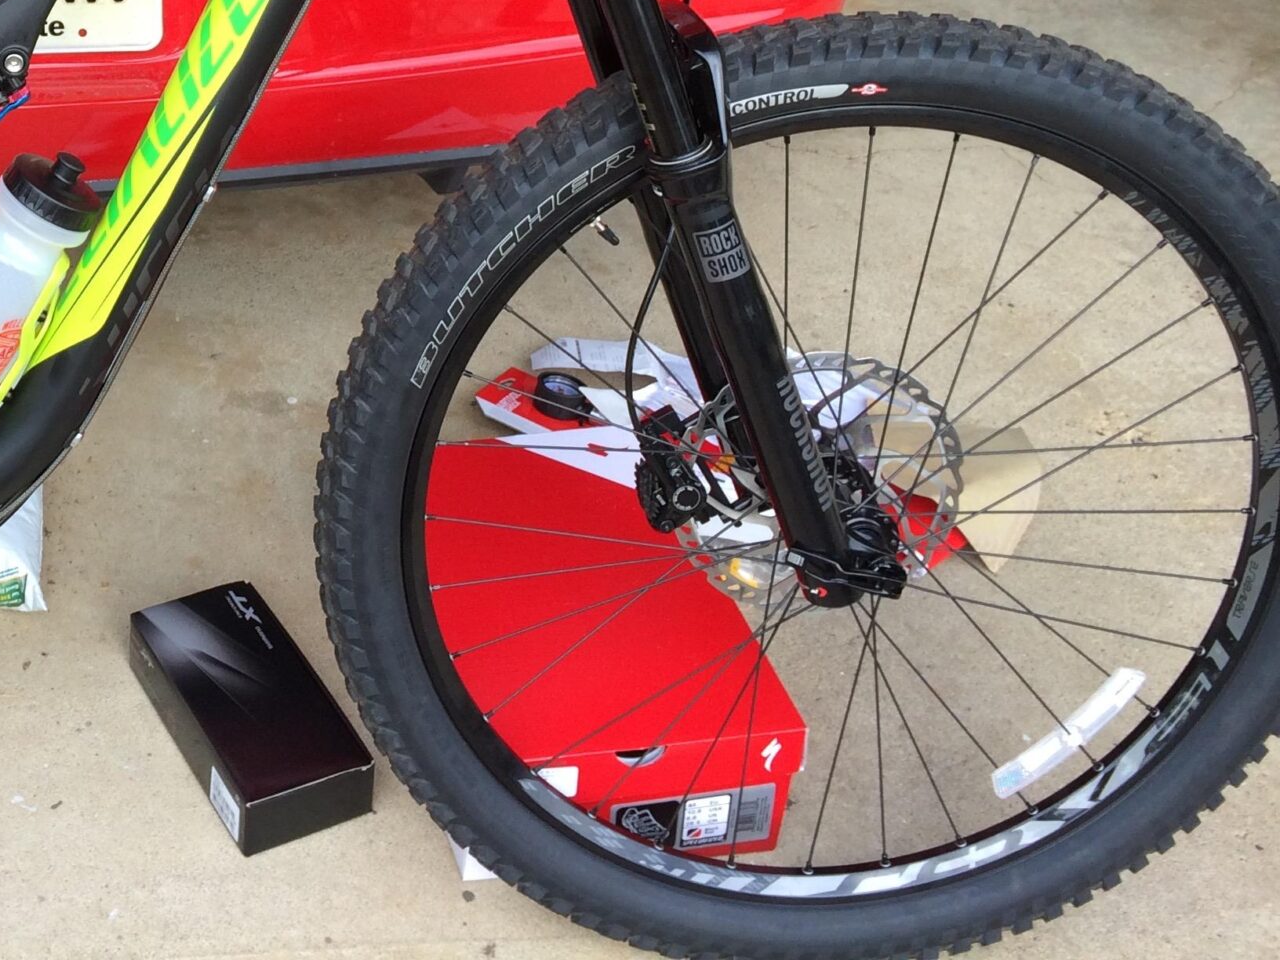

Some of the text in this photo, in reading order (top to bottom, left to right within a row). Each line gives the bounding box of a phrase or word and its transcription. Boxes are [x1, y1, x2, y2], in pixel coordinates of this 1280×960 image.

[731, 88, 819, 117] CONTROL
[699, 224, 740, 257] ROCK
[409, 144, 637, 389] BUTCHER
[707, 248, 747, 279] SHOX
